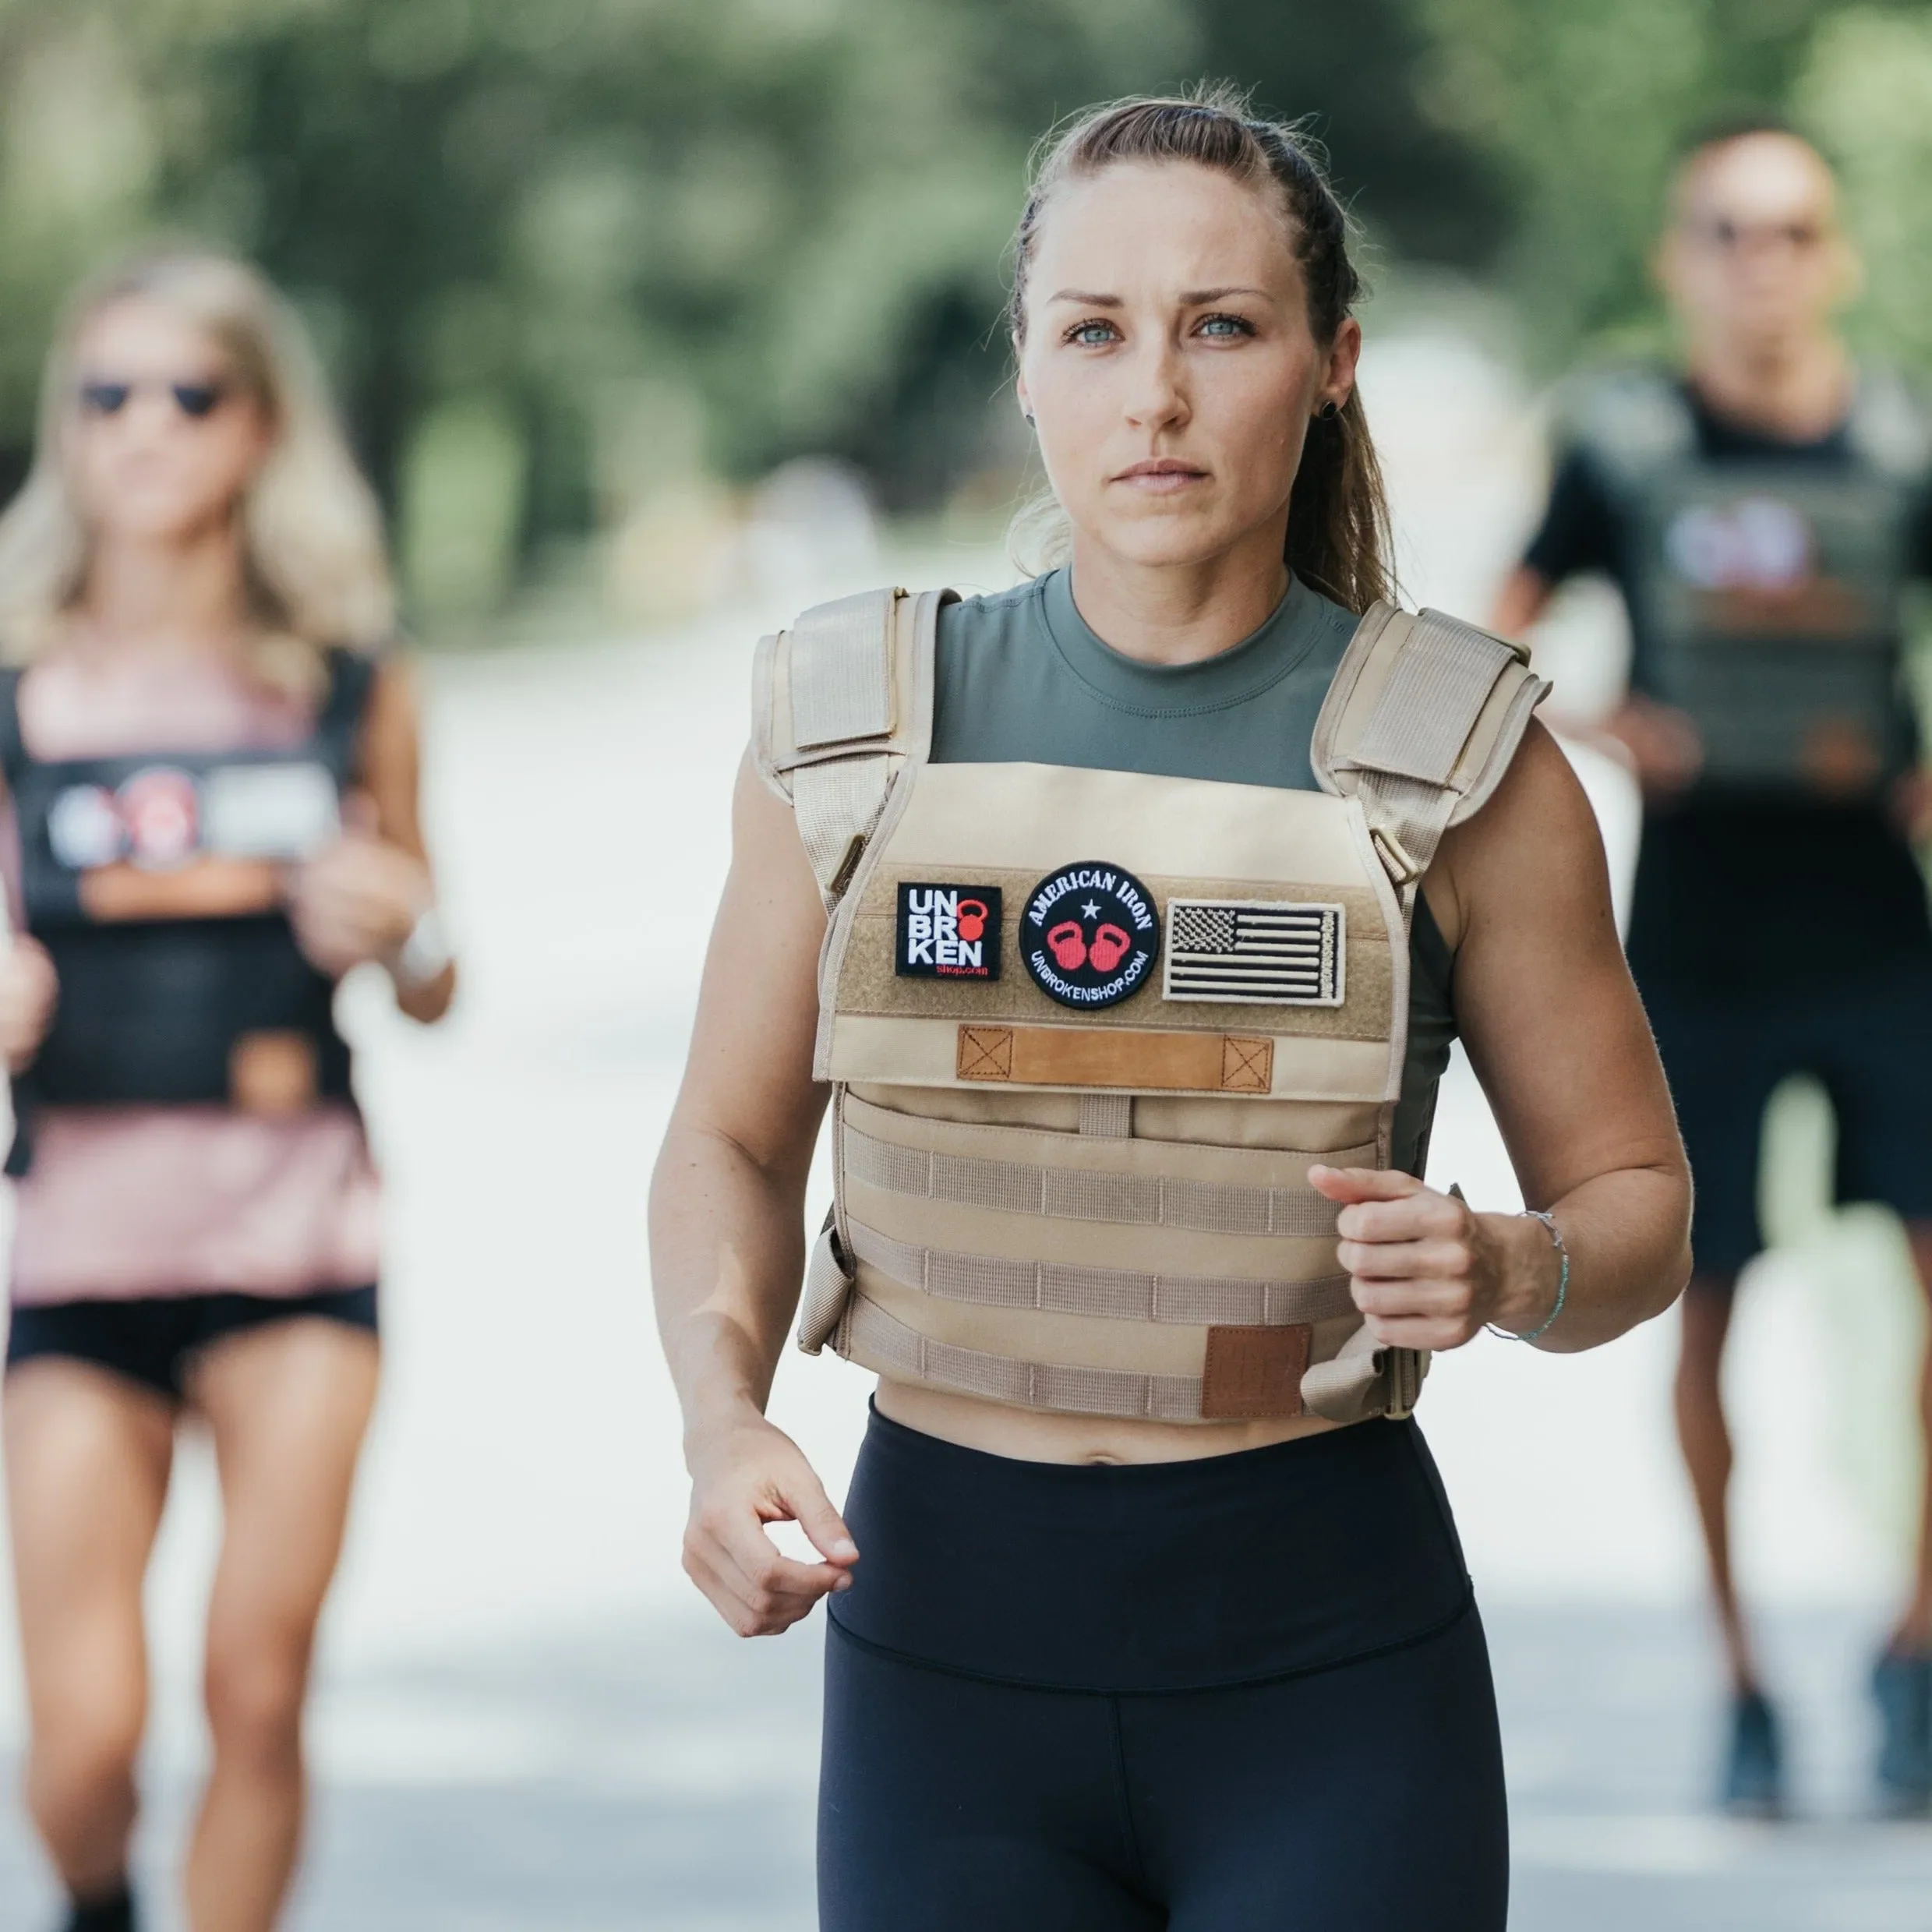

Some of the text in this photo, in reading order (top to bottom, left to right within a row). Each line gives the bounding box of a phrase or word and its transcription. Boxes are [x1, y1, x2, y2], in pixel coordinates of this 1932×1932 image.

[909, 888, 958, 917] UN
[1029, 870, 1153, 931] AMERICAN IRON
[908, 938, 982, 967] KEN
[936, 965, 988, 976] shop.com
[1031, 950, 1149, 1001] UNBROKENSHOP.COM
